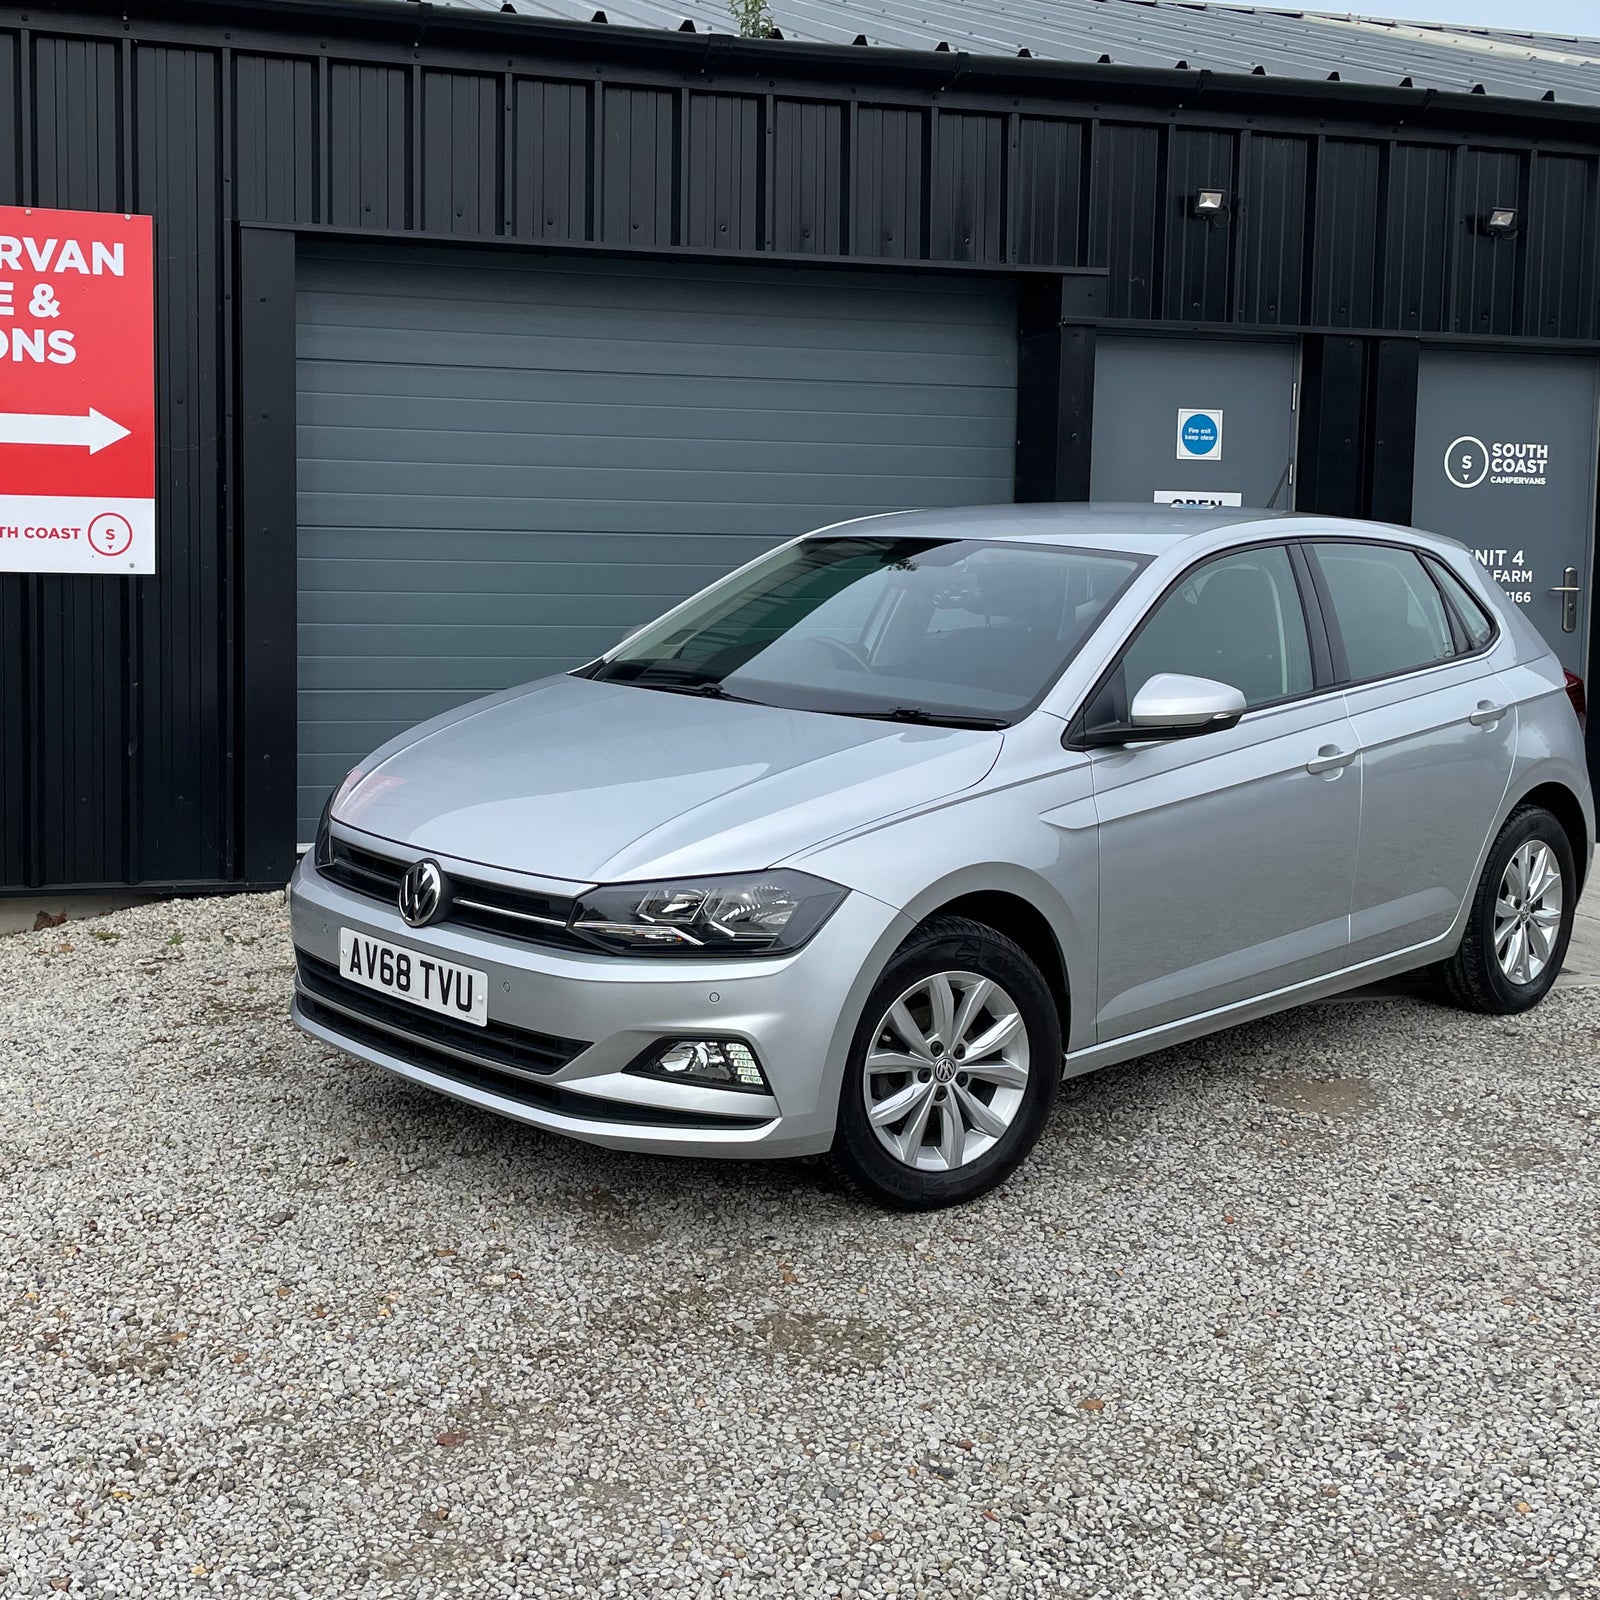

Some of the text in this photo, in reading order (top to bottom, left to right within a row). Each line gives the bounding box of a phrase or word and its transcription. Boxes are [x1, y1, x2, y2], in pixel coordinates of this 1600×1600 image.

[28, 283, 61, 318] &
[0, 327, 77, 365] NS
[1491, 442, 1549, 459] SOUTH
[1461, 455, 1472, 470] S
[1491, 457, 1548, 474] COAST
[1490, 475, 1547, 486] CAMPERVANS
[23, 527, 81, 540] COAST
[105, 528, 116, 541] S
[1470, 549, 1525, 567] NIT 4
[1492, 569, 1533, 583] FARM
[349, 937, 473, 1013] AV68 TVU
